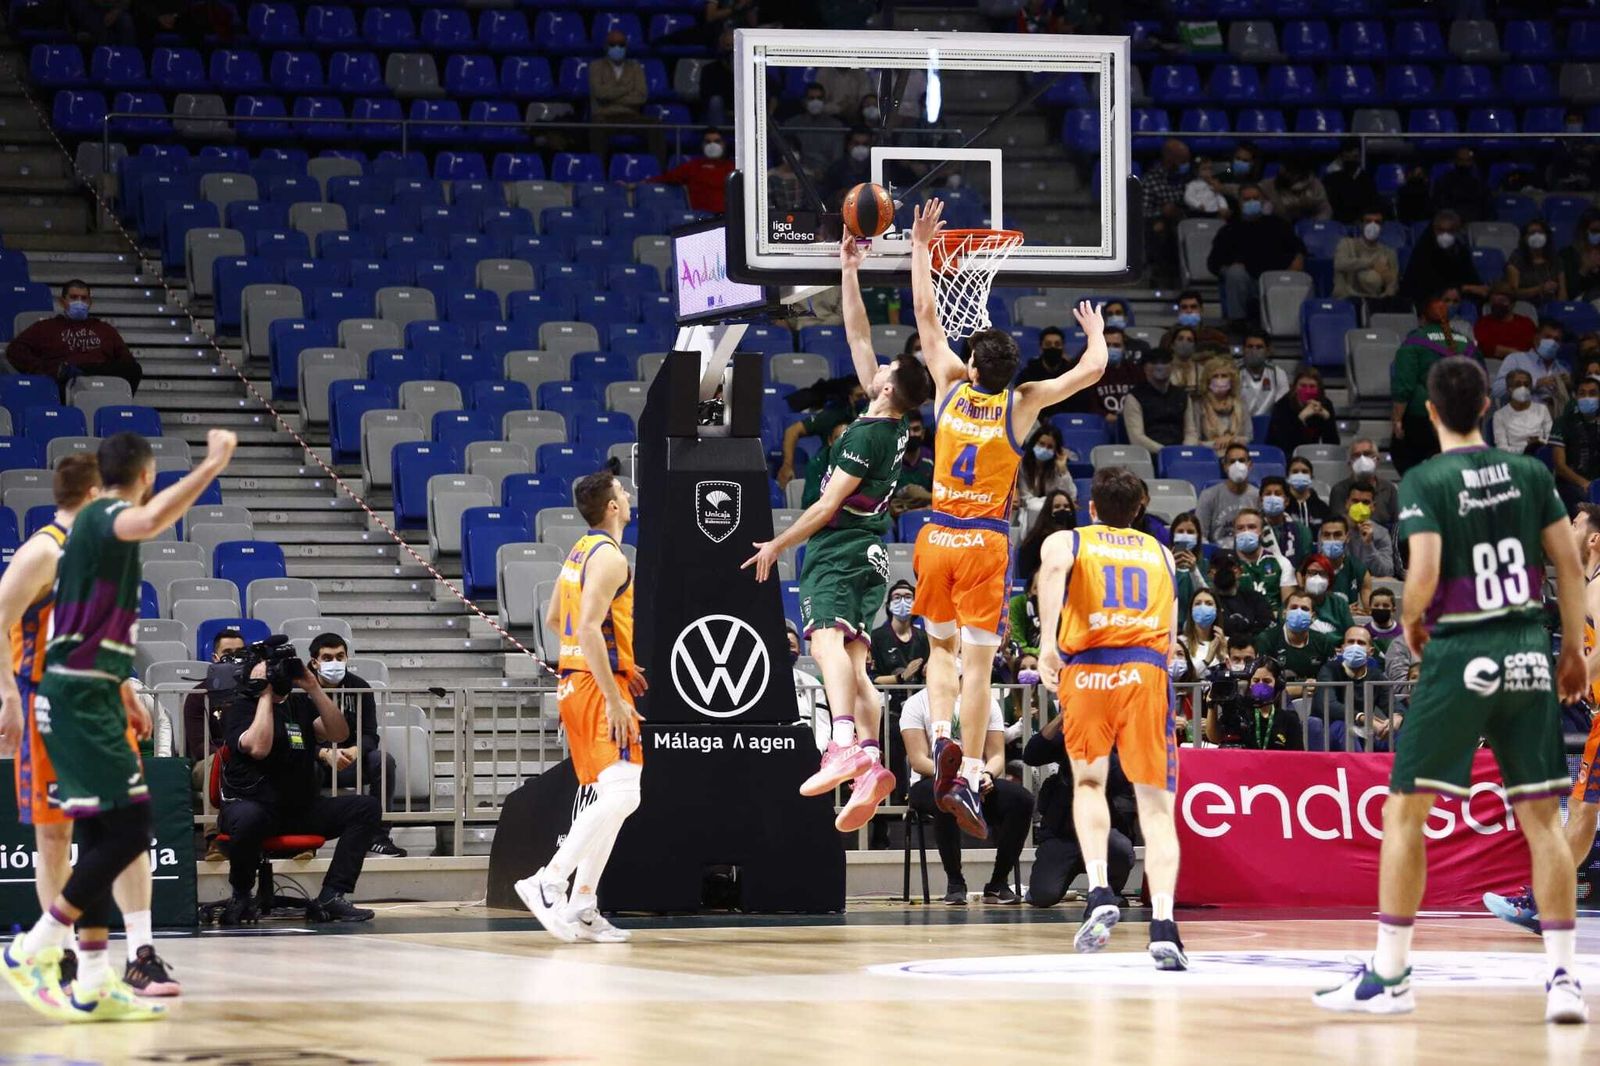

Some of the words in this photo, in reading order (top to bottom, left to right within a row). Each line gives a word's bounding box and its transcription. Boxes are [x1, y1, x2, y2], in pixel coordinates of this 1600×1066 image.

[773, 220, 792, 232] liga
[773, 231, 815, 241] endesa
[951, 443, 979, 486] 4
[705, 511, 731, 520] Unicaja
[1097, 531, 1145, 547] TOBEY
[1473, 537, 1531, 611] 83
[1102, 565, 1148, 611] 10
[654, 732, 724, 753] Málaga
